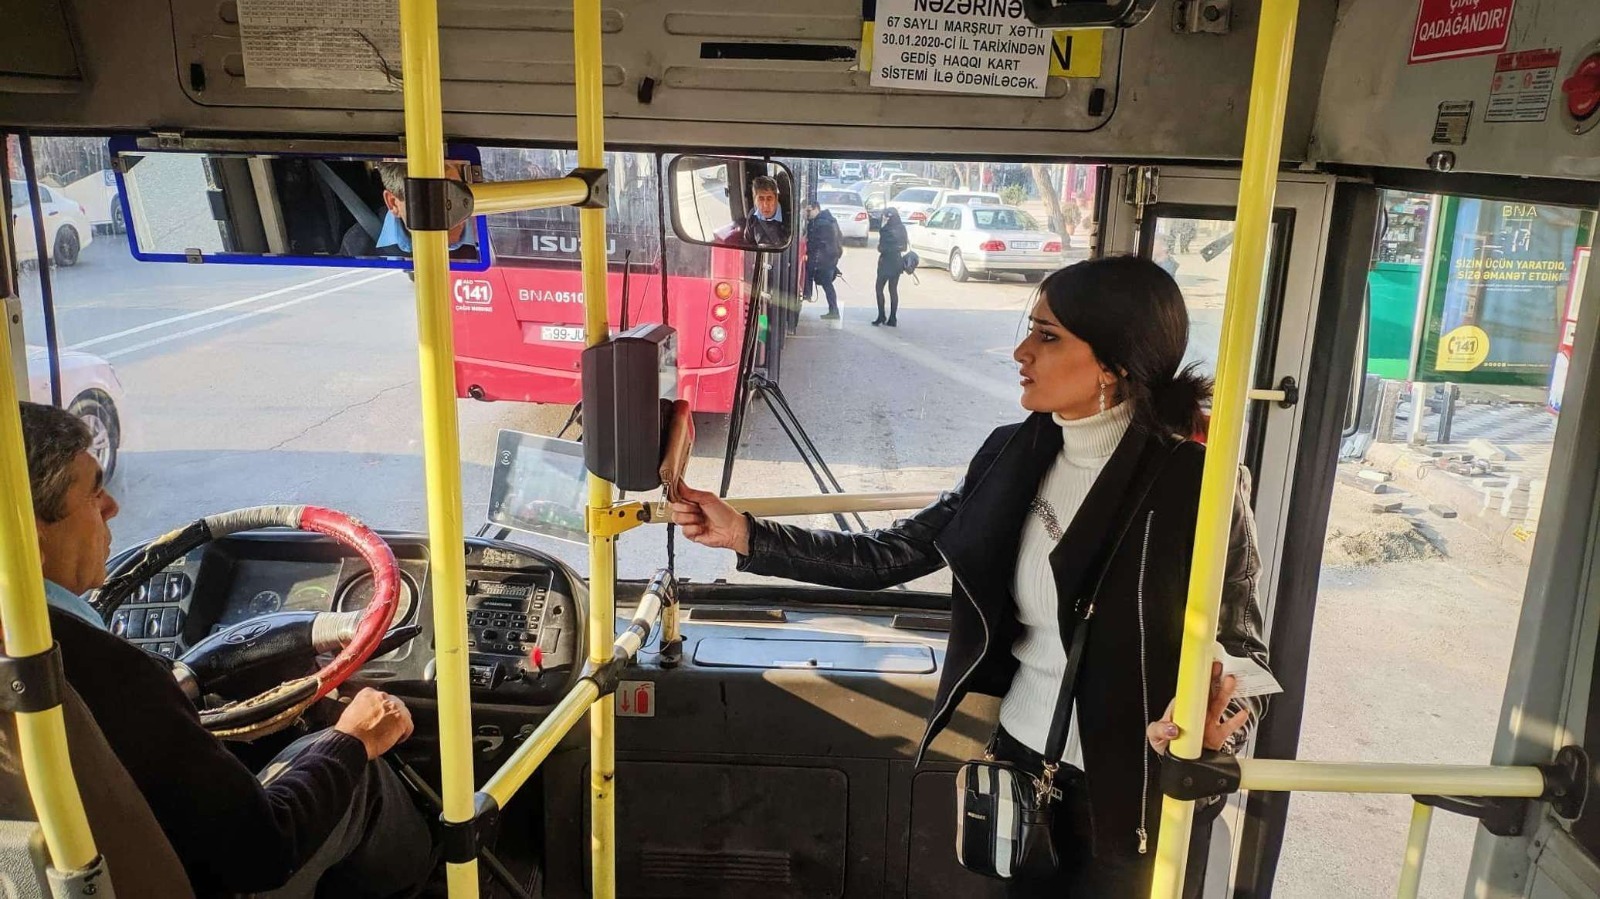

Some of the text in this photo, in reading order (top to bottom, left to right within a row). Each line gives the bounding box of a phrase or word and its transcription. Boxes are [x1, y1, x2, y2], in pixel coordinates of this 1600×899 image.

[887, 16, 900, 28] 67
[903, 17, 938, 31] SAYLI
[944, 20, 1003, 37] MARŞRUT
[1419, 7, 1507, 41] QADAĞANDIR!
[882, 33, 1045, 56] 30.01.2020-Cİ İL TARİXİNDƏN
[901, 51, 1021, 71] GEDİŞ HAQQI KART
[881, 65, 1038, 90] SİSTEMİ İLƏ ÖDƏNİLƏCƏK.
[1502, 205, 1538, 217] BNA
[1485, 258, 1513, 271] ÜÇÜN
[1483, 271, 1526, 281] ƏMANƏT
[463, 284, 488, 301] 141
[1455, 340, 1475, 352] 141
